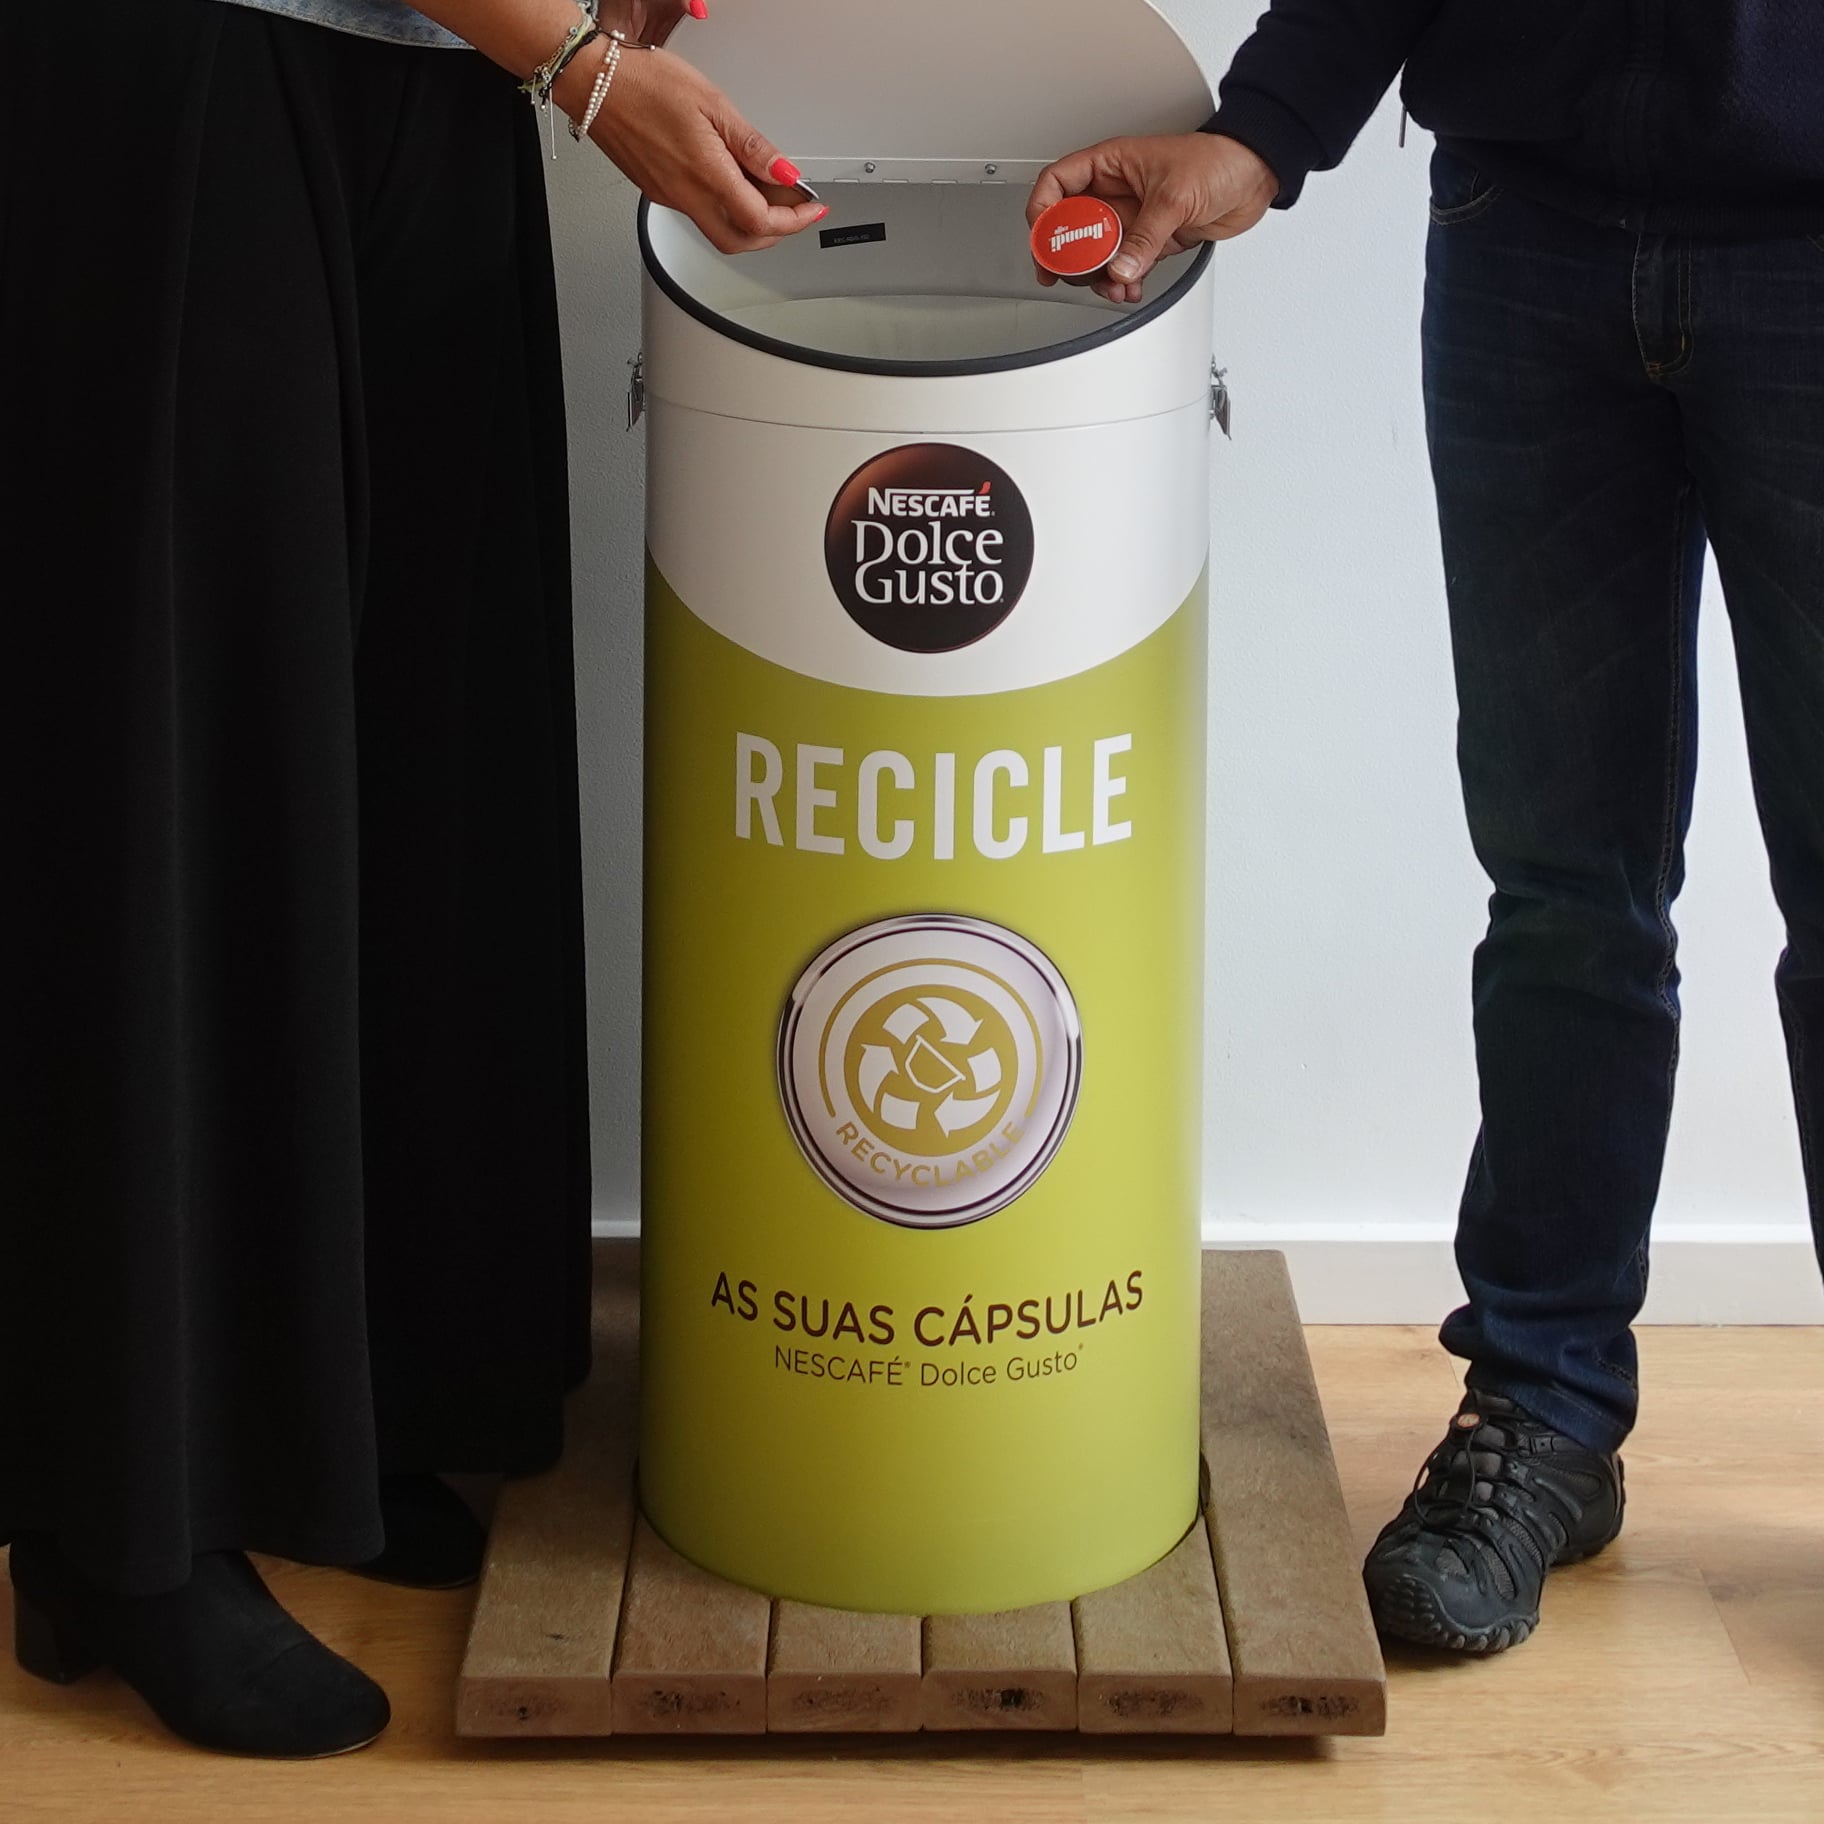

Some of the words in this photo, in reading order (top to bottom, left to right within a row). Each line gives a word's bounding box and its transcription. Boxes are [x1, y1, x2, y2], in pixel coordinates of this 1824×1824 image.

[851, 519, 1004, 565] Dolce
[855, 562, 1004, 605] Gusto
[735, 731, 1133, 860] RECICLE
[836, 1122, 1025, 1187] RECYCLABLE
[711, 1271, 759, 1321] AS
[773, 1290, 895, 1345] SUAS
[913, 1270, 1143, 1347] CÁPSULAS
[921, 1360, 997, 1387] Dolce
